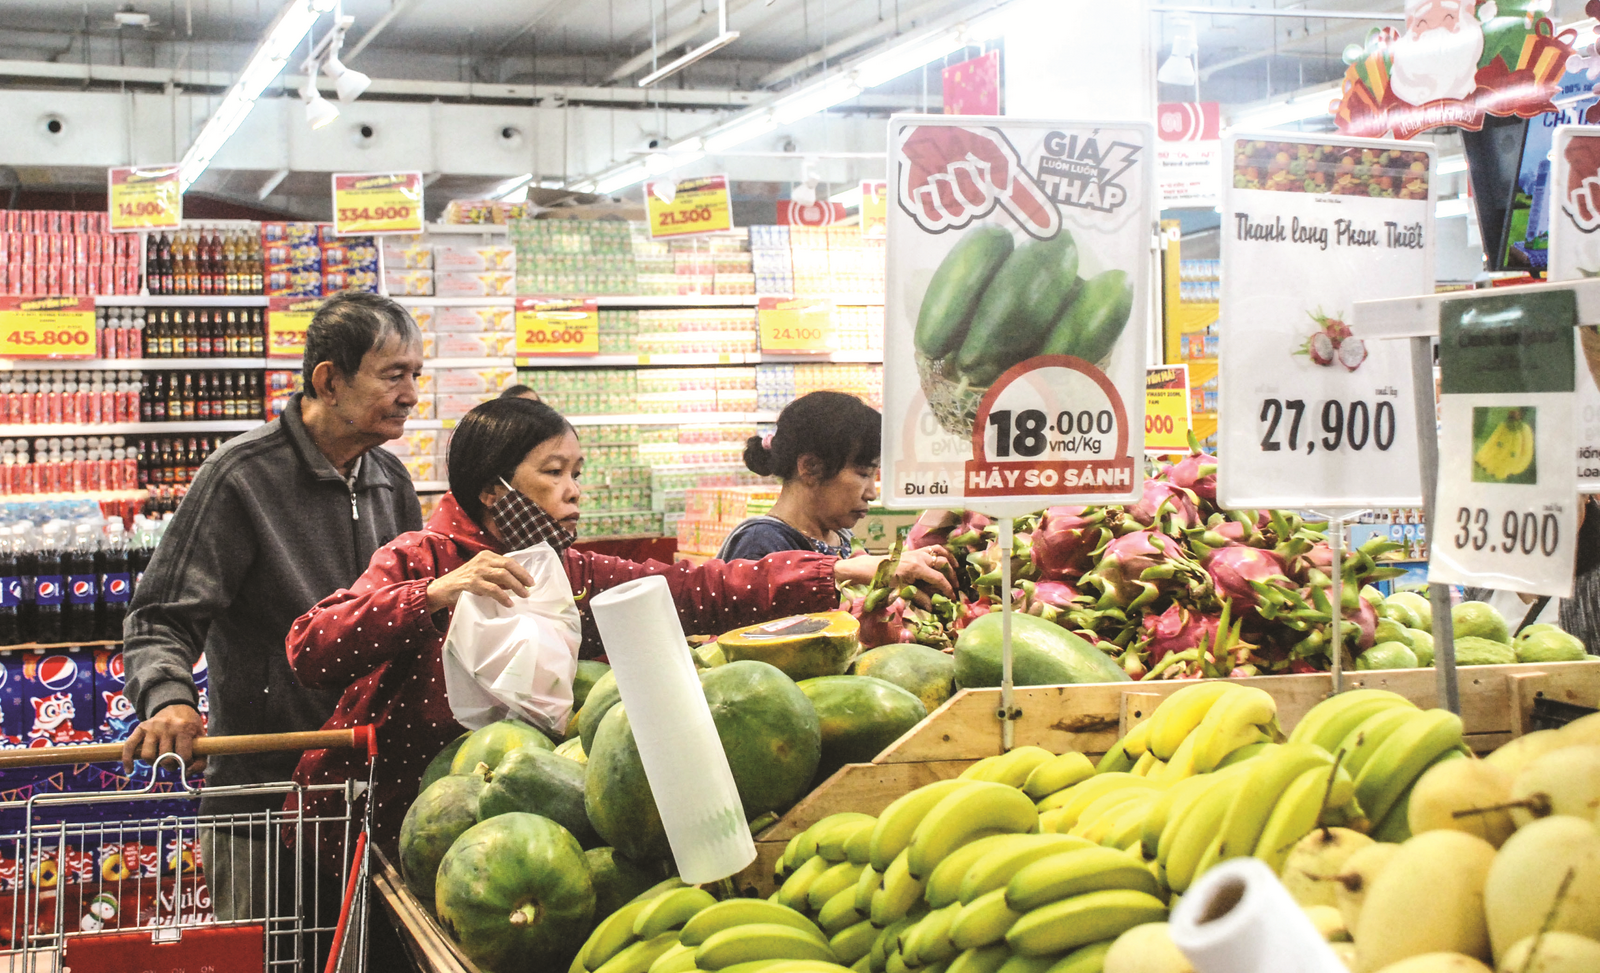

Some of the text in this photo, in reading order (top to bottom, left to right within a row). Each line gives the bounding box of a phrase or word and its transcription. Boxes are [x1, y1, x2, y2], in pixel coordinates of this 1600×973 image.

[1043, 128, 1101, 163] GIÁ
[1042, 159, 1098, 176] LUÔN LUÔN
[338, 206, 410, 222] 334.900
[659, 208, 711, 226] 21.300
[1235, 212, 1424, 251] Thanh long Phan Thiết
[6, 330, 90, 346] 45.800
[274, 331, 307, 346] 323
[525, 330, 584, 344] 20.900
[773, 328, 821, 340] 24.100
[988, 409, 1113, 457] 18.000
[1145, 414, 1174, 434] 000
[1260, 398, 1396, 456] 27,900
[1049, 436, 1102, 454] vnd/Kg
[969, 464, 1131, 490] HÃY SO SÁNH
[904, 480, 949, 496] Đu đủ
[1454, 507, 1559, 557] 33.900
